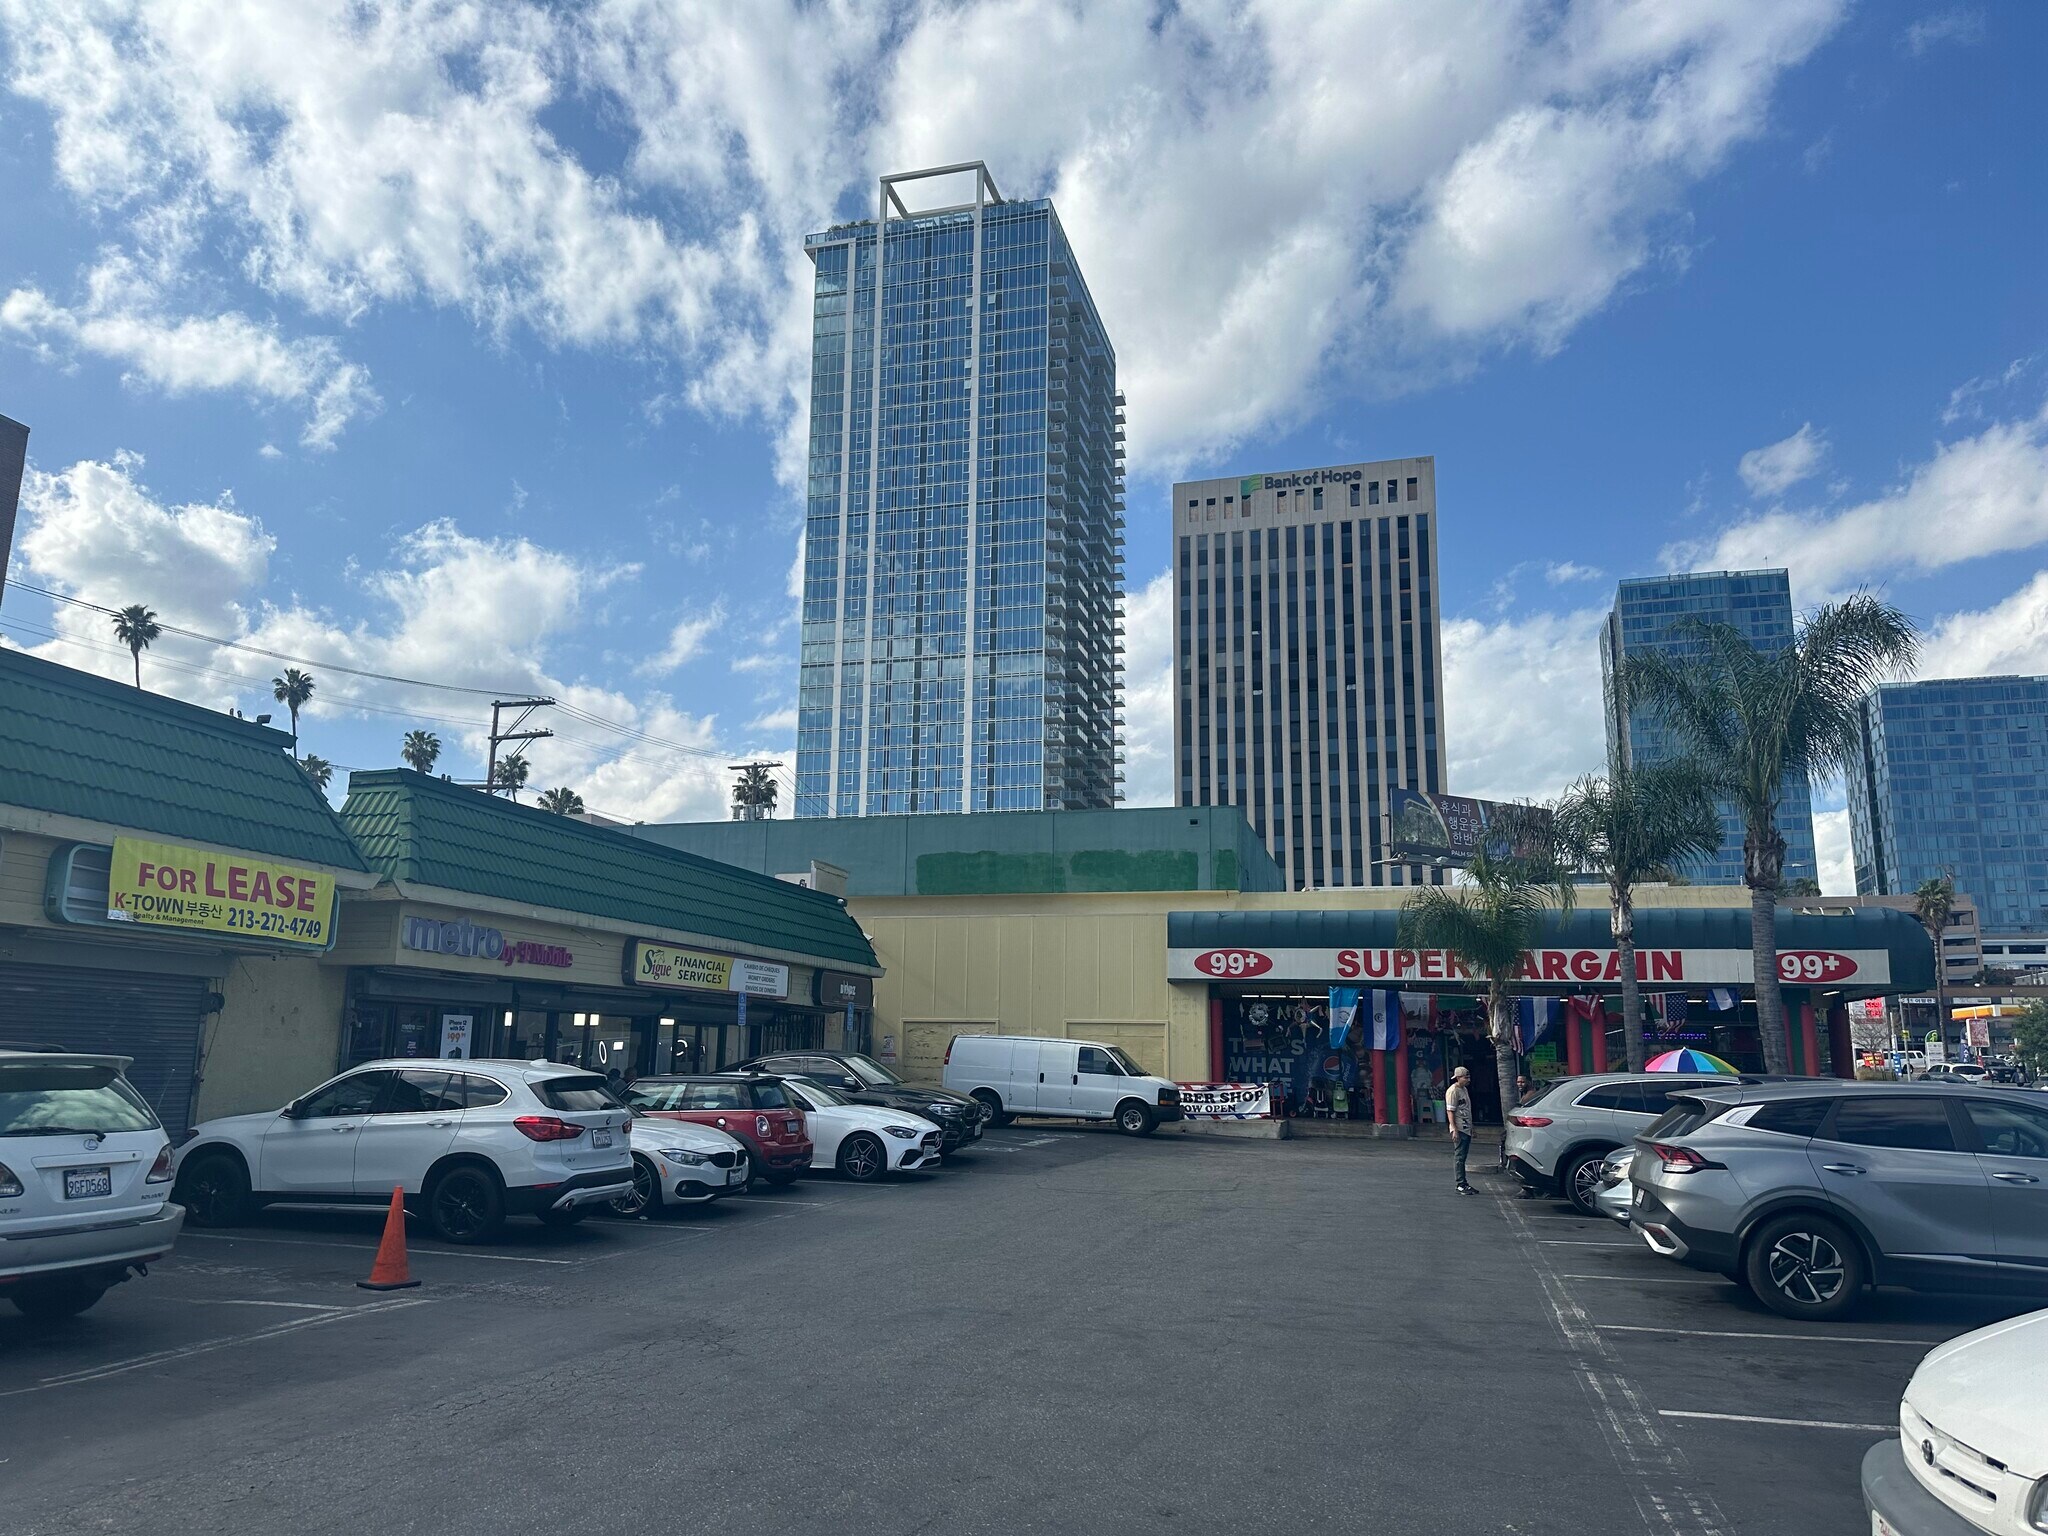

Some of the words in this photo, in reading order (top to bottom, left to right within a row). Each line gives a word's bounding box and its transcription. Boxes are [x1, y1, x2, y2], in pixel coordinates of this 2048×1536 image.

[1264, 475, 1301, 490] Bank
[1302, 471, 1319, 486] of
[1321, 469, 1362, 485] Hope
[1440, 800, 1472, 818] 휴식과
[138, 862, 197, 894] FOR
[204, 862, 317, 913] LEASE
[114, 892, 184, 915] K-TOWN
[186, 900, 222, 920] 부동산
[162, 914, 204, 925] Management
[227, 906, 322, 939] 213-272-4749
[404, 916, 504, 960] metro
[501, 939, 515, 967] by
[642, 949, 672, 980] Sigue
[674, 956, 727, 973] FINANCIAL
[1210, 953, 1258, 974] 99+
[1337, 950, 1472, 978] SUPER
[1487, 951, 1683, 981] ARGAIN
[1781, 955, 1840, 979] 99+
[677, 969, 723, 985] SERVICES
[1230, 1056, 1295, 1075] WHAT
[1181, 1092, 1215, 1104] BER
[1219, 1090, 1264, 1104] SHOP
[1181, 1104, 1203, 1113] OW
[1205, 1104, 1236, 1113] OPEN
[68, 1177, 108, 1194] 9GFD568
